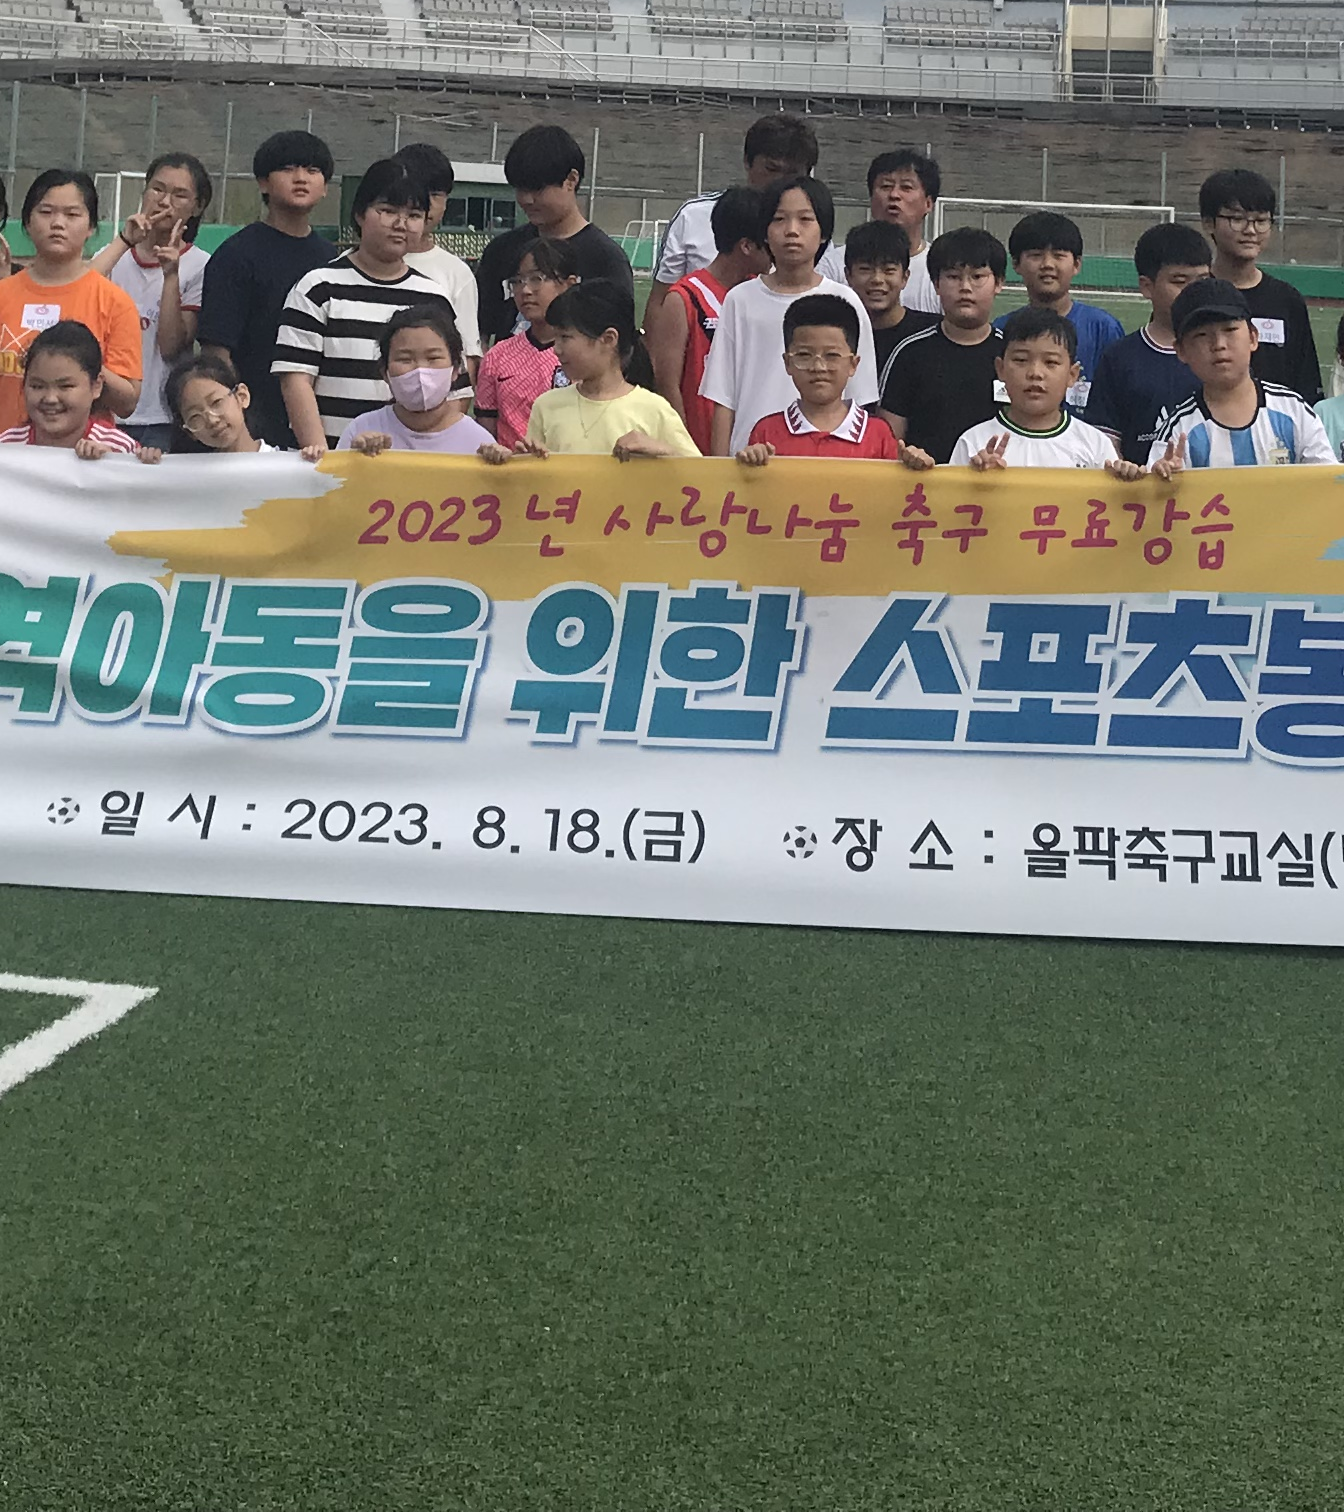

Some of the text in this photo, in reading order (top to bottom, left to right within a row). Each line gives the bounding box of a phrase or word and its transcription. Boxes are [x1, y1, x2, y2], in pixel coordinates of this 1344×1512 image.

[357, 493, 502, 546] 2023
[603, 486, 861, 563] 사랑나눔
[890, 482, 989, 566] 축구
[1019, 493, 1234, 571] 무료강습
[507, 582, 801, 748] 위한
[281, 797, 442, 851] 2023.
[472, 804, 521, 855] 8.
[543, 806, 706, 865] 18.(금)
